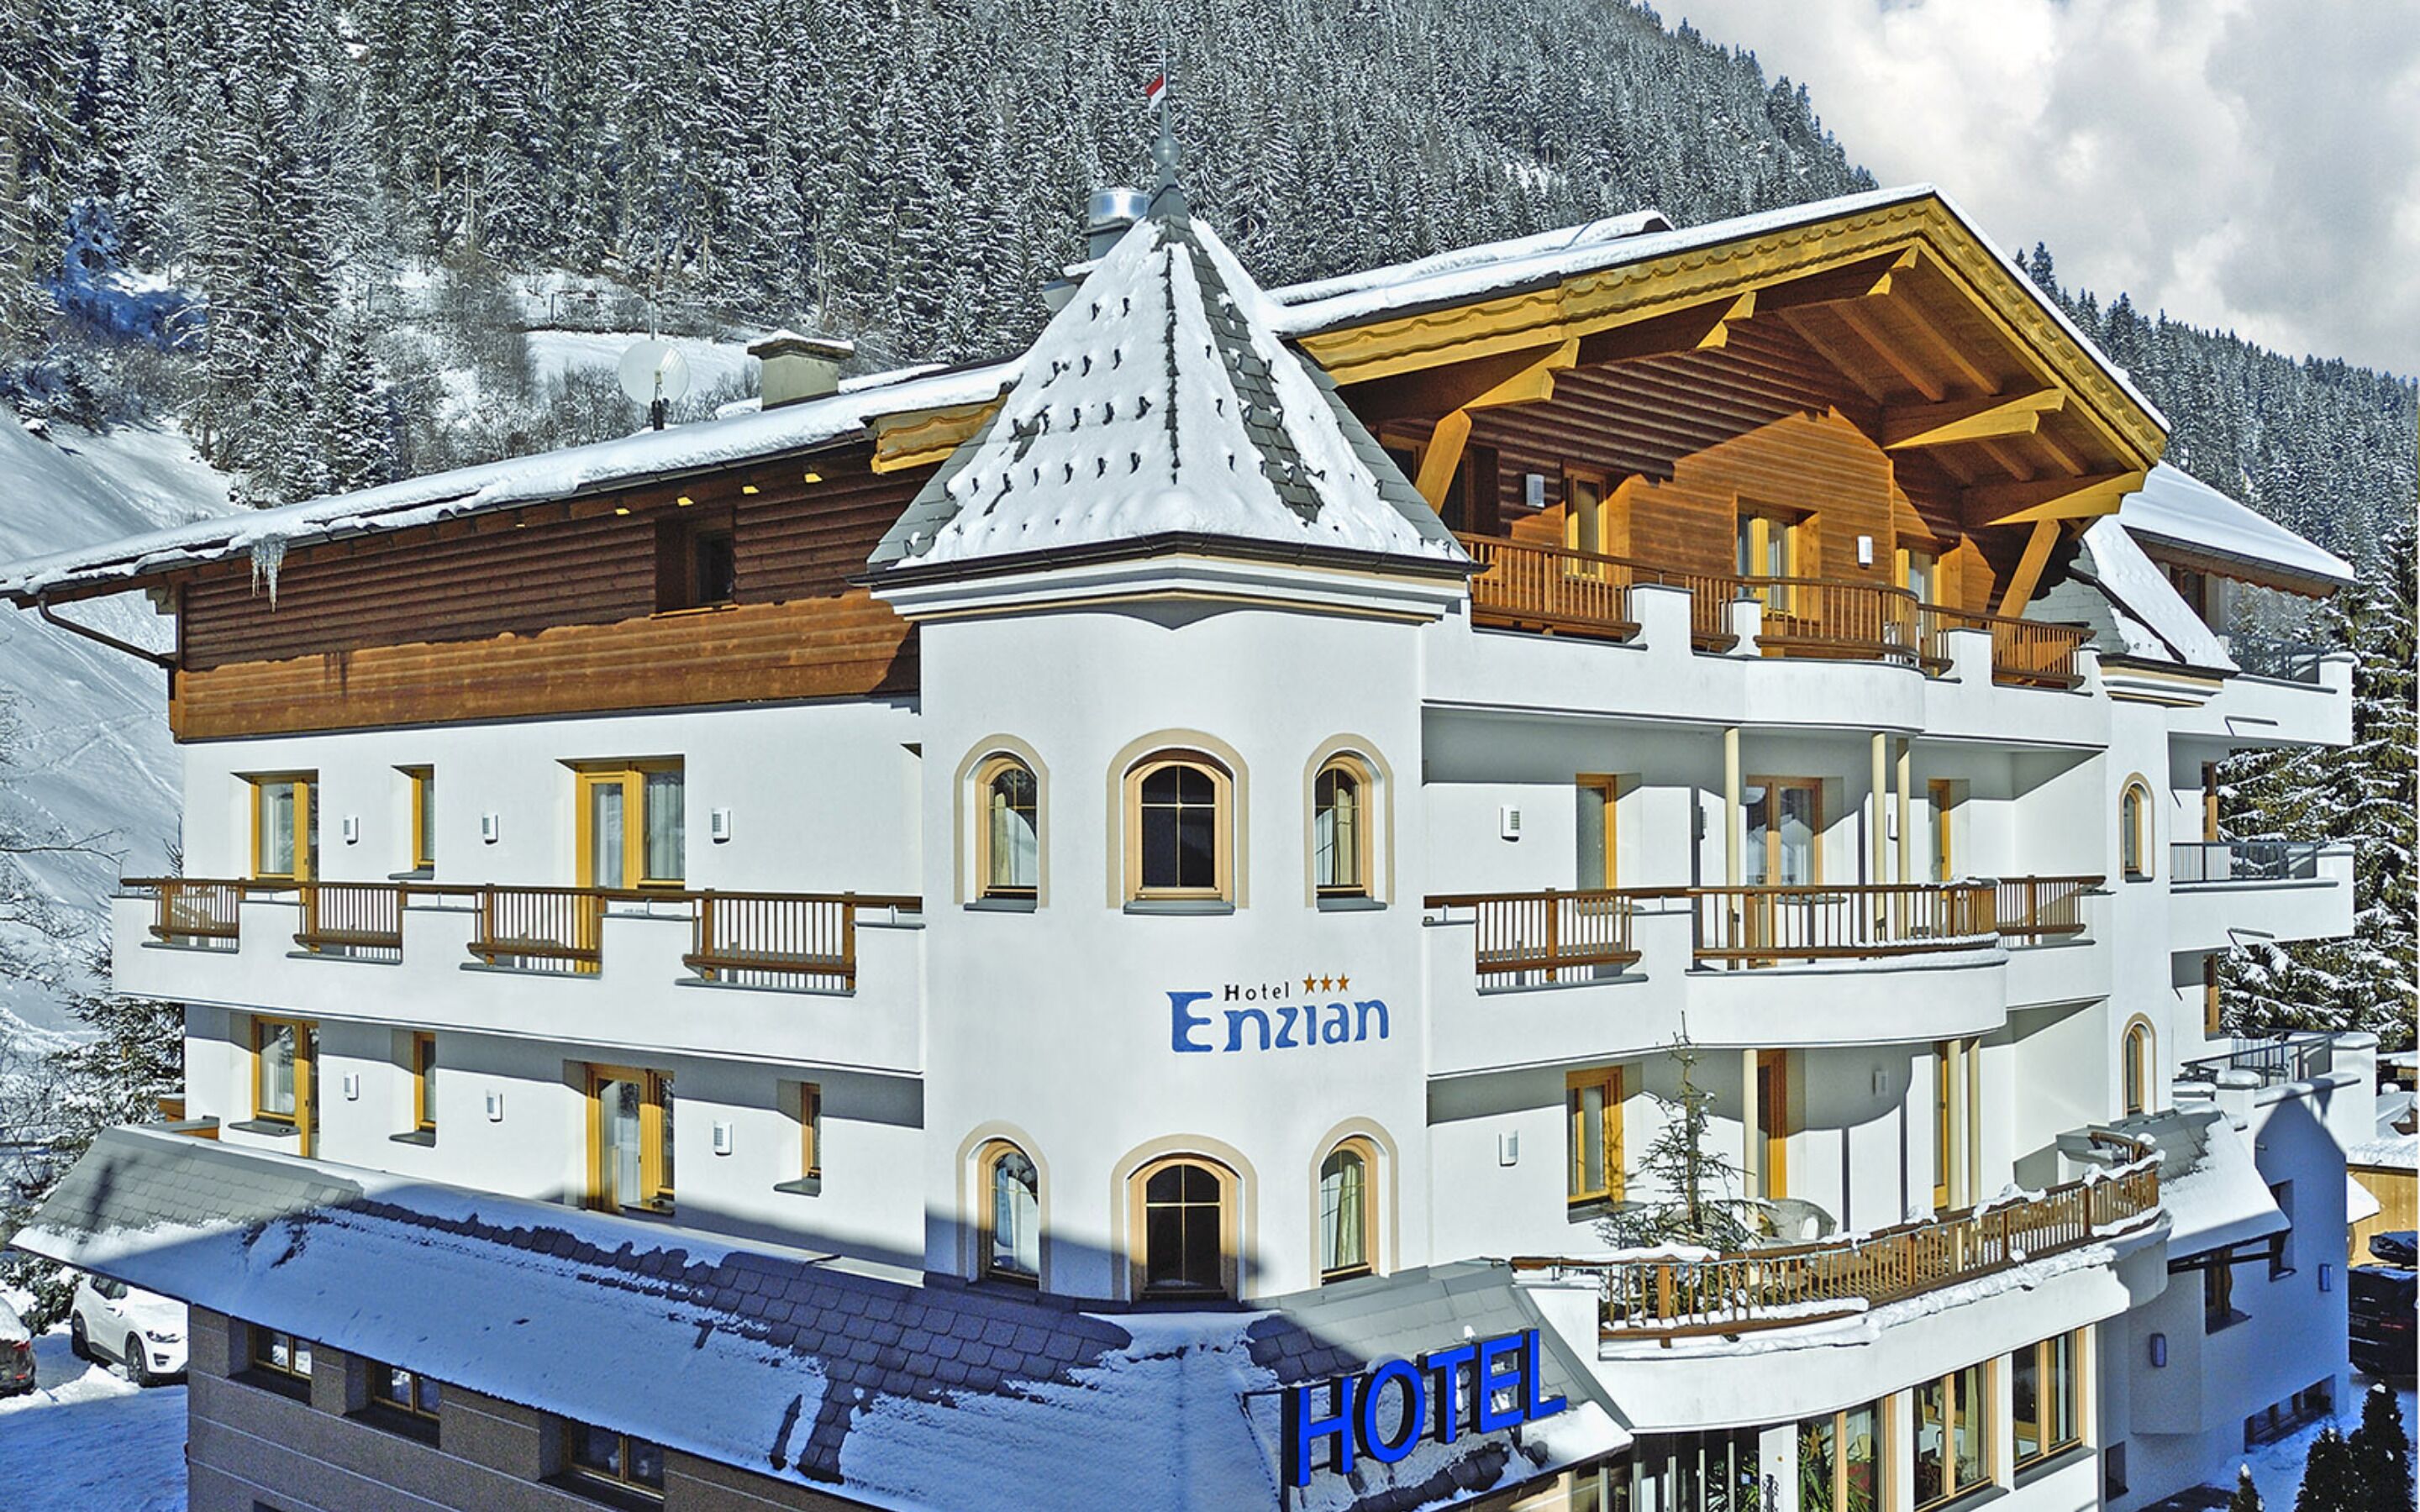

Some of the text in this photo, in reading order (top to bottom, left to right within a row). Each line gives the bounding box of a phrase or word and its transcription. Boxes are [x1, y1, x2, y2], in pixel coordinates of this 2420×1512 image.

[1165, 991, 1390, 1052] Enzian
[1224, 982, 1290, 1001] Hotel
[1287, 1328, 1567, 1488] HOTEL
